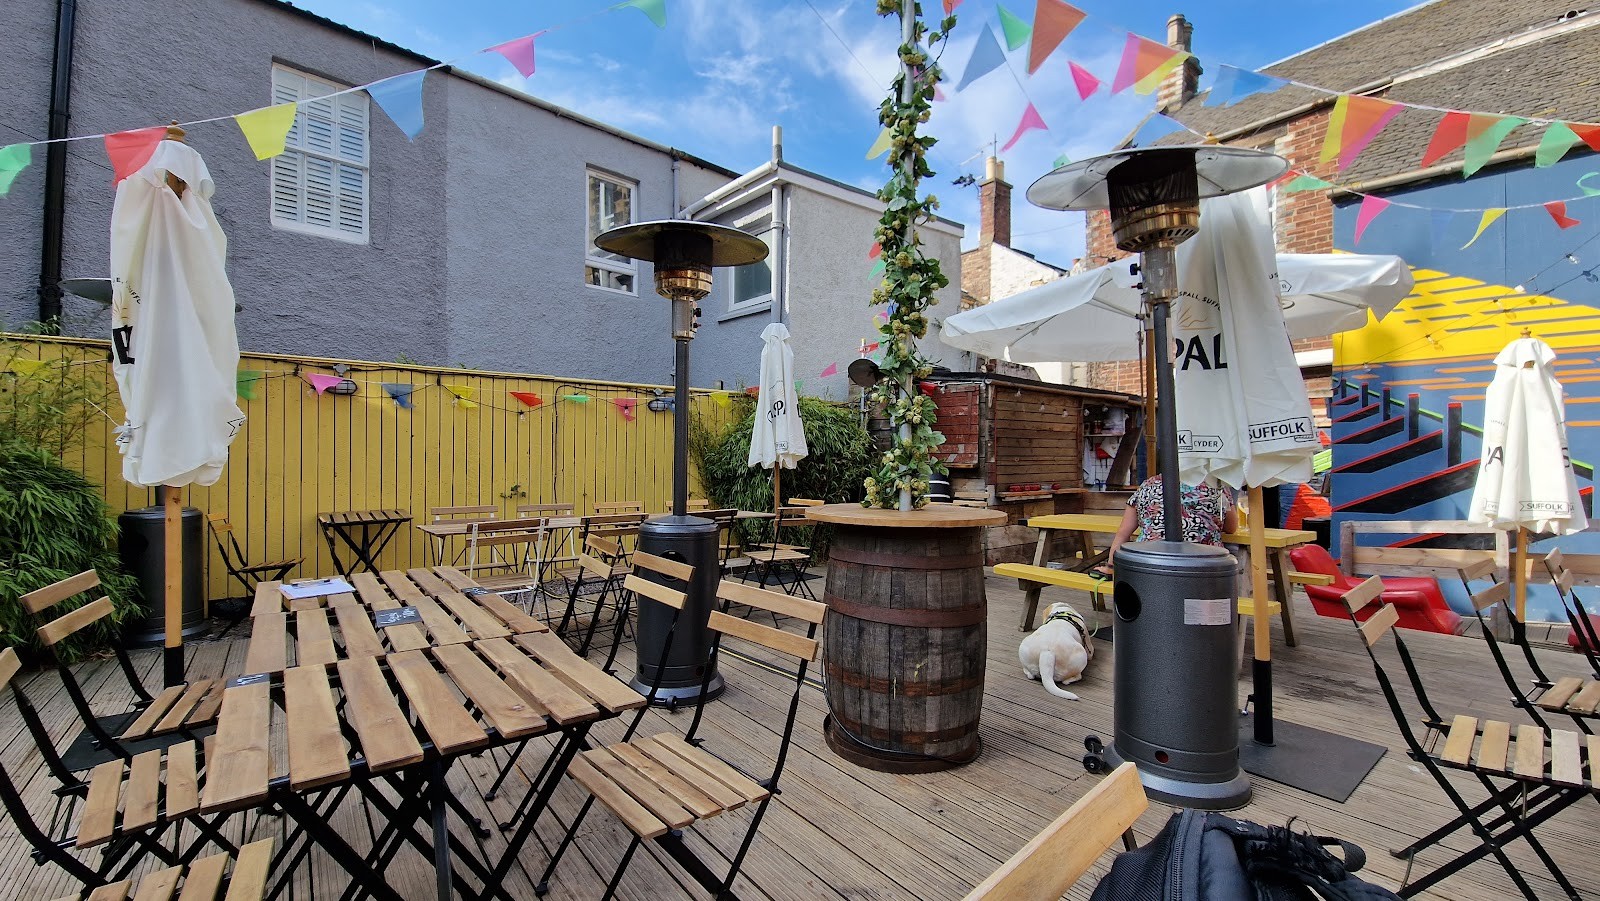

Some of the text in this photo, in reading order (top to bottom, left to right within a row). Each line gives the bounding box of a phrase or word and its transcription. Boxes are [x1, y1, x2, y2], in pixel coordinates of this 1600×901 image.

[1248, 421, 1306, 441] SUFFOLK
[1193, 440, 1219, 448] CYDER
[1526, 502, 1564, 510] SUFFOLK
